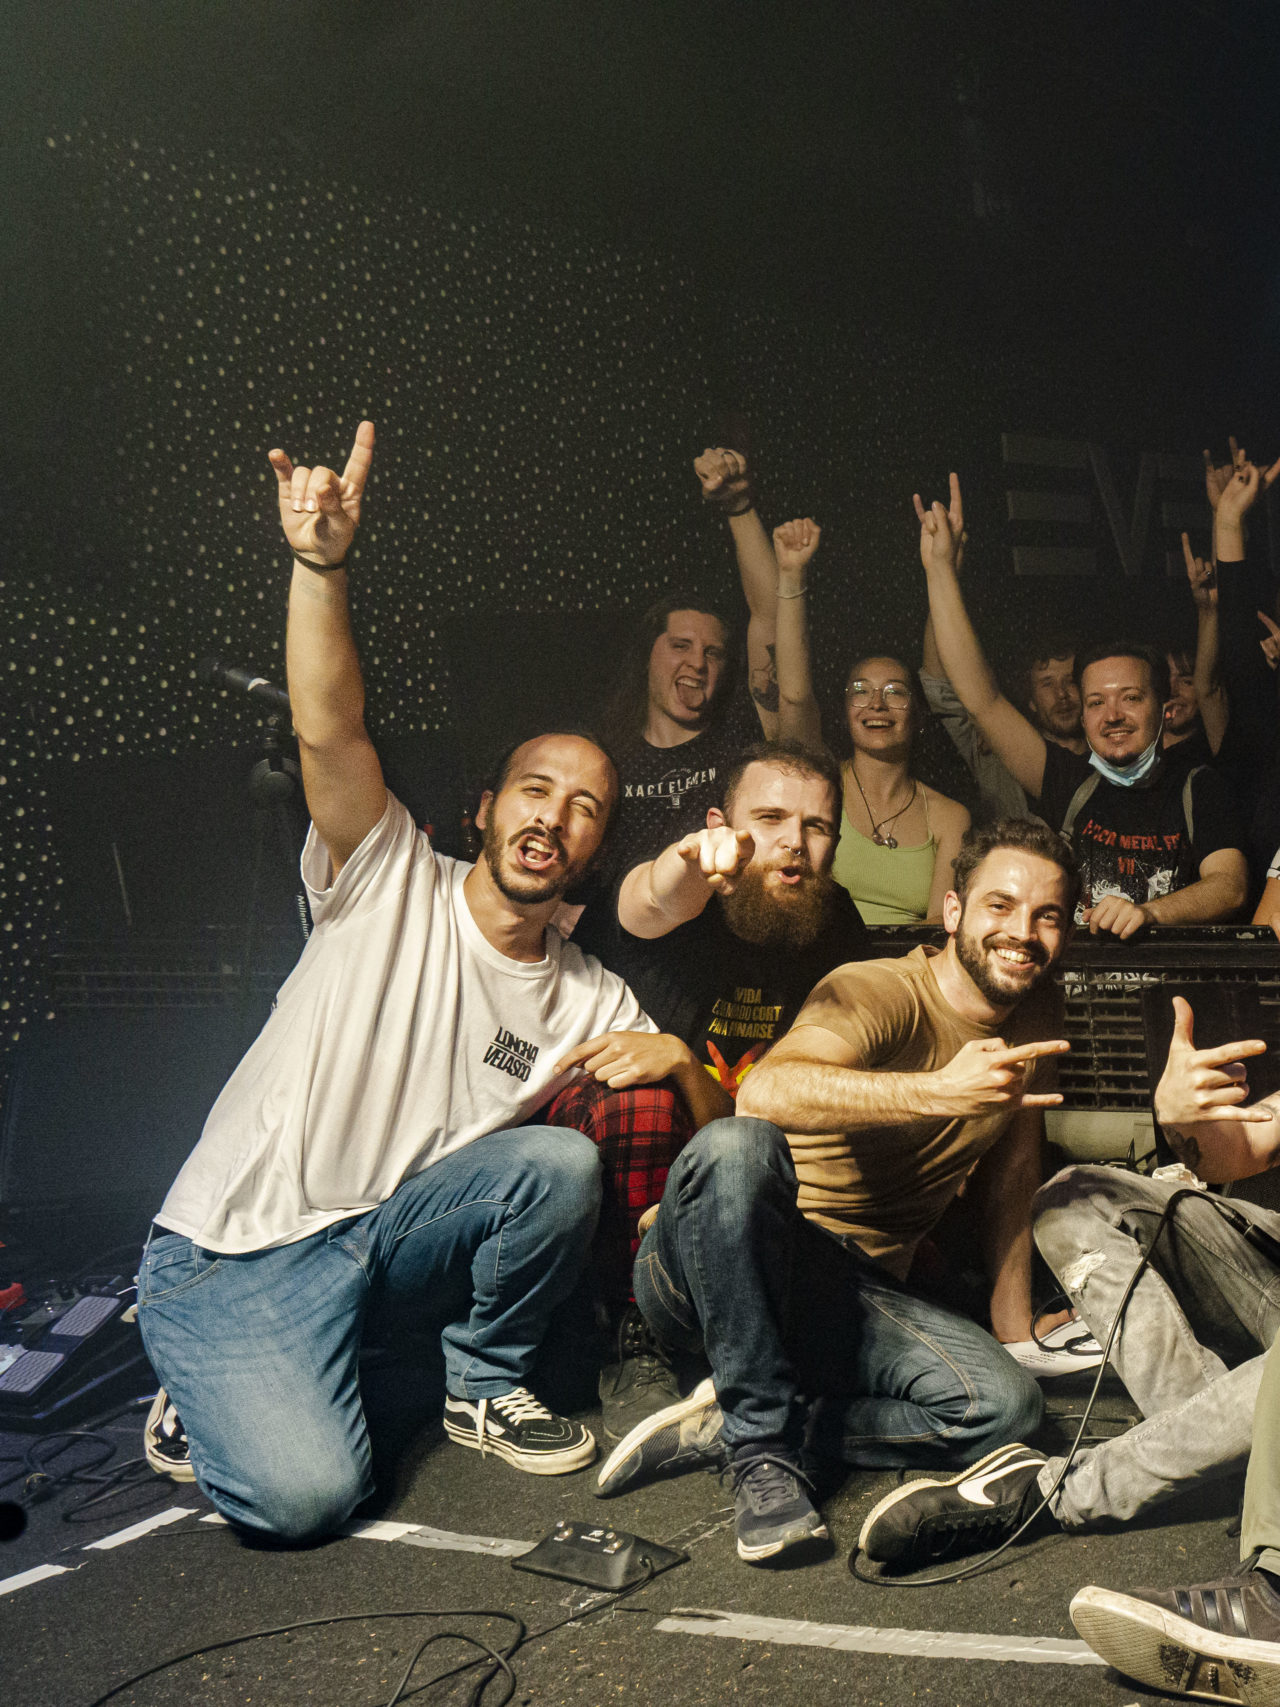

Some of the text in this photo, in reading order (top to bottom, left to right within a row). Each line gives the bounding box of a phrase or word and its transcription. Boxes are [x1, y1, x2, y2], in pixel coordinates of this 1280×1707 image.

[1119, 834, 1163, 851] METAL
[482, 1044, 532, 1083] VELASCO
[494, 1025, 540, 1064] LONCHA
